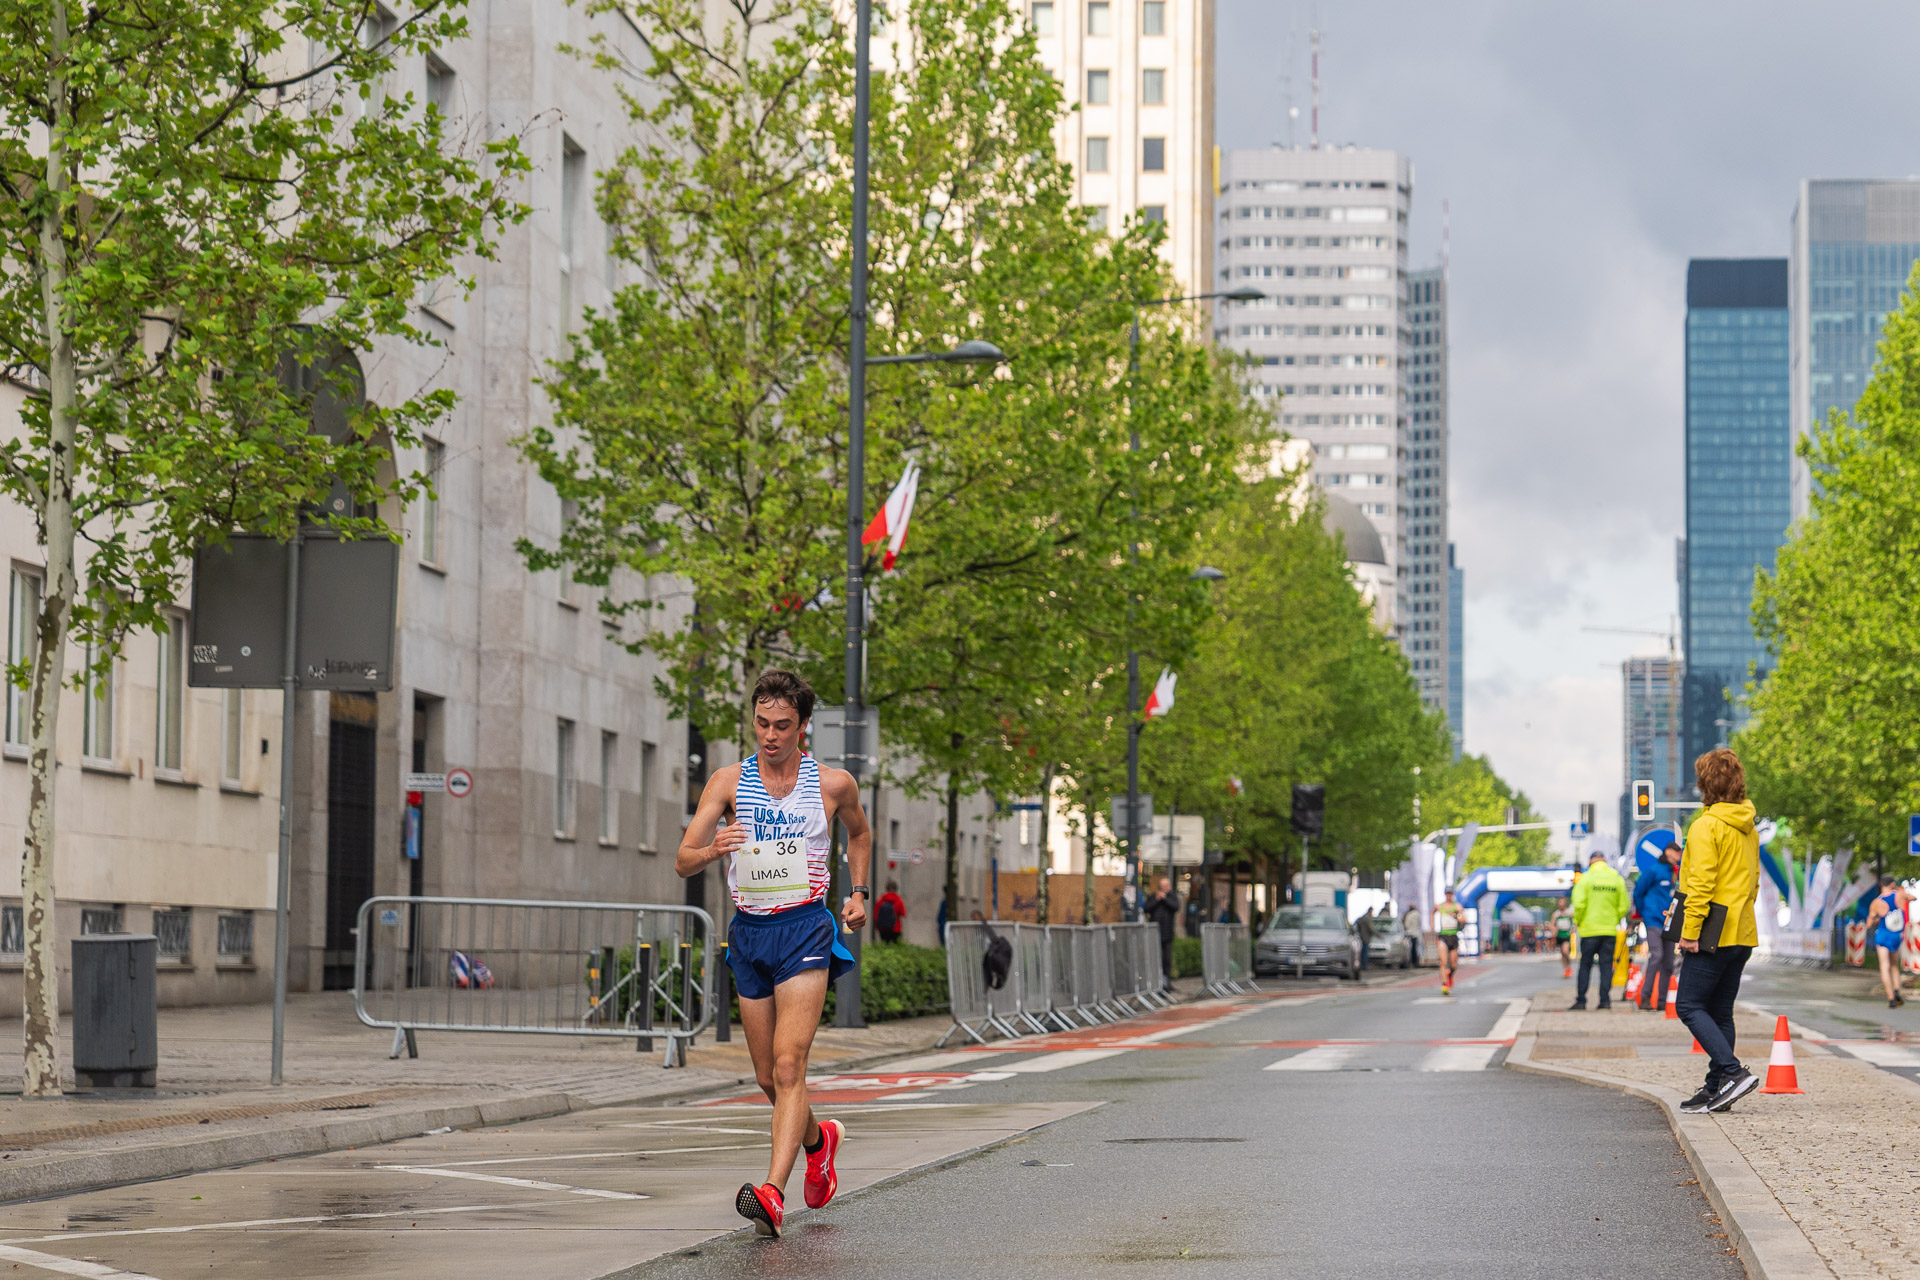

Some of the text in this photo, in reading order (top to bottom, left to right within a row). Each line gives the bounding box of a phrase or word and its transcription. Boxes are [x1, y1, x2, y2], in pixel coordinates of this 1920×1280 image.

[754, 807, 807, 825] USA Race
[776, 840, 797, 856] 36
[751, 868, 788, 880] LIMAS
